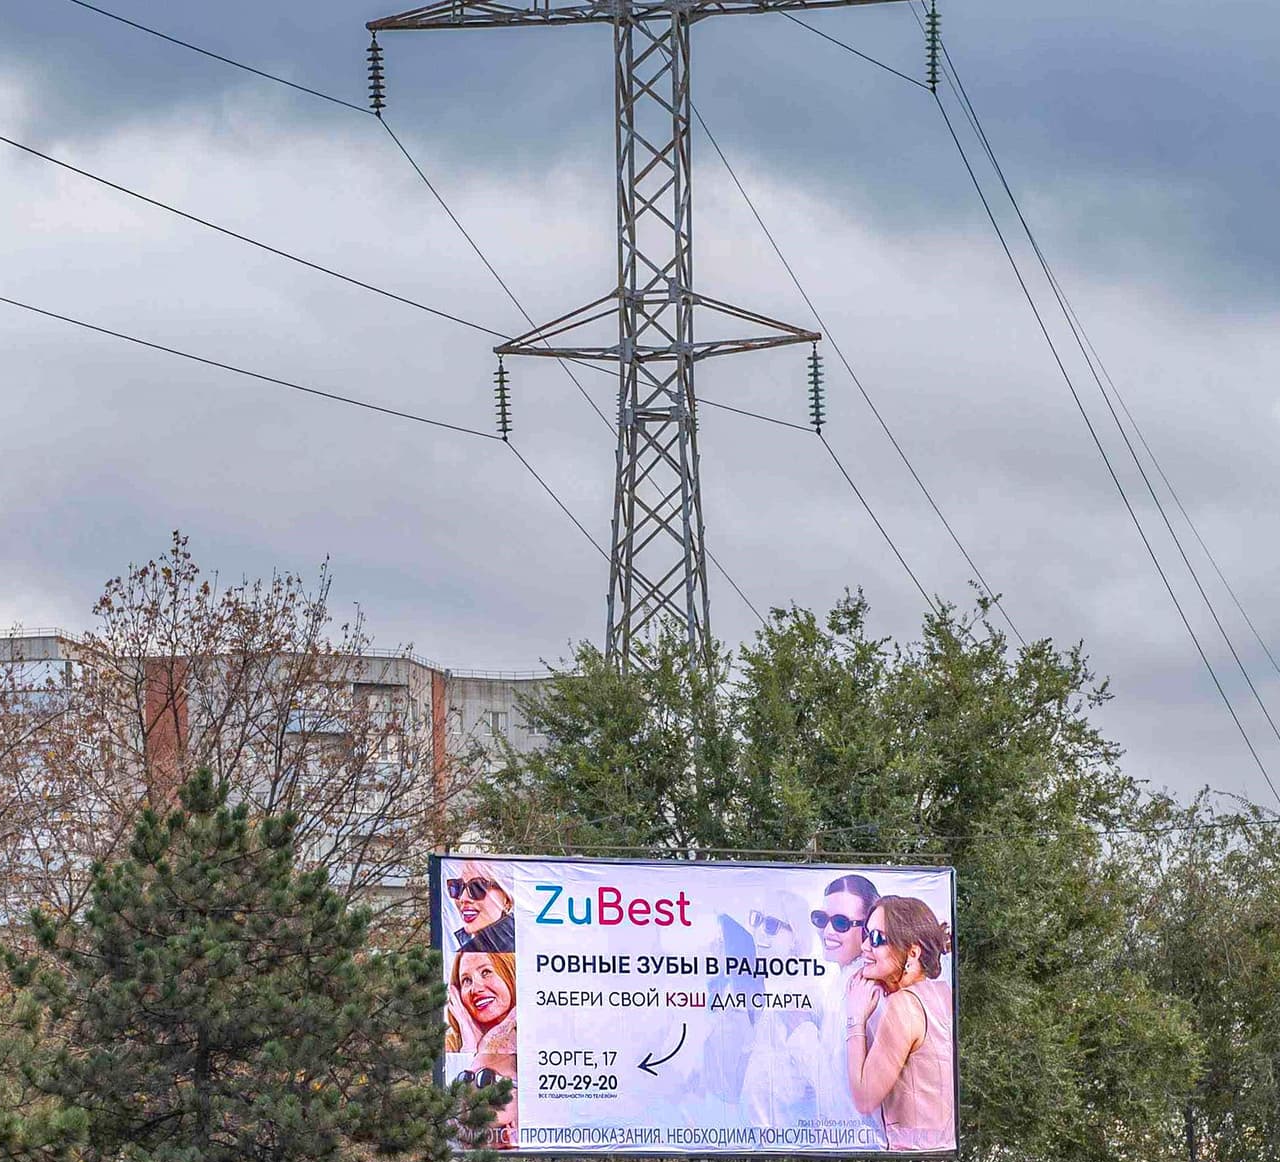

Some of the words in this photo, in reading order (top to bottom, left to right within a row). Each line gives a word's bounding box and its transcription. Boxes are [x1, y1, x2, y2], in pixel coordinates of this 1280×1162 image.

[535, 885, 692, 927] ZuBest
[536, 954, 631, 974] РОВНЫЕ
[636, 955, 698, 975] ЗУБЫ
[705, 957, 719, 975] В
[725, 957, 826, 979] РАДОСТЬ
[536, 990, 603, 1008] ЗАБЕРИ
[608, 987, 659, 1008] СВОЙ
[666, 992, 706, 1008] КЭШ
[711, 993, 746, 1010] ДЛЯ
[752, 993, 813, 1009] СТАРТА
[538, 1050, 598, 1069] ЗОРГЕ,
[602, 1051, 618, 1066] 17
[538, 1074, 618, 1090] 270-29-20
[520, 1127, 664, 1144] ПРОТИВОПОКАЗАНИЯ.
[668, 1128, 755, 1147] НЕОБХОДИМА
[759, 1128, 855, 1146] КОНСУЛЬТАЦИЯ
